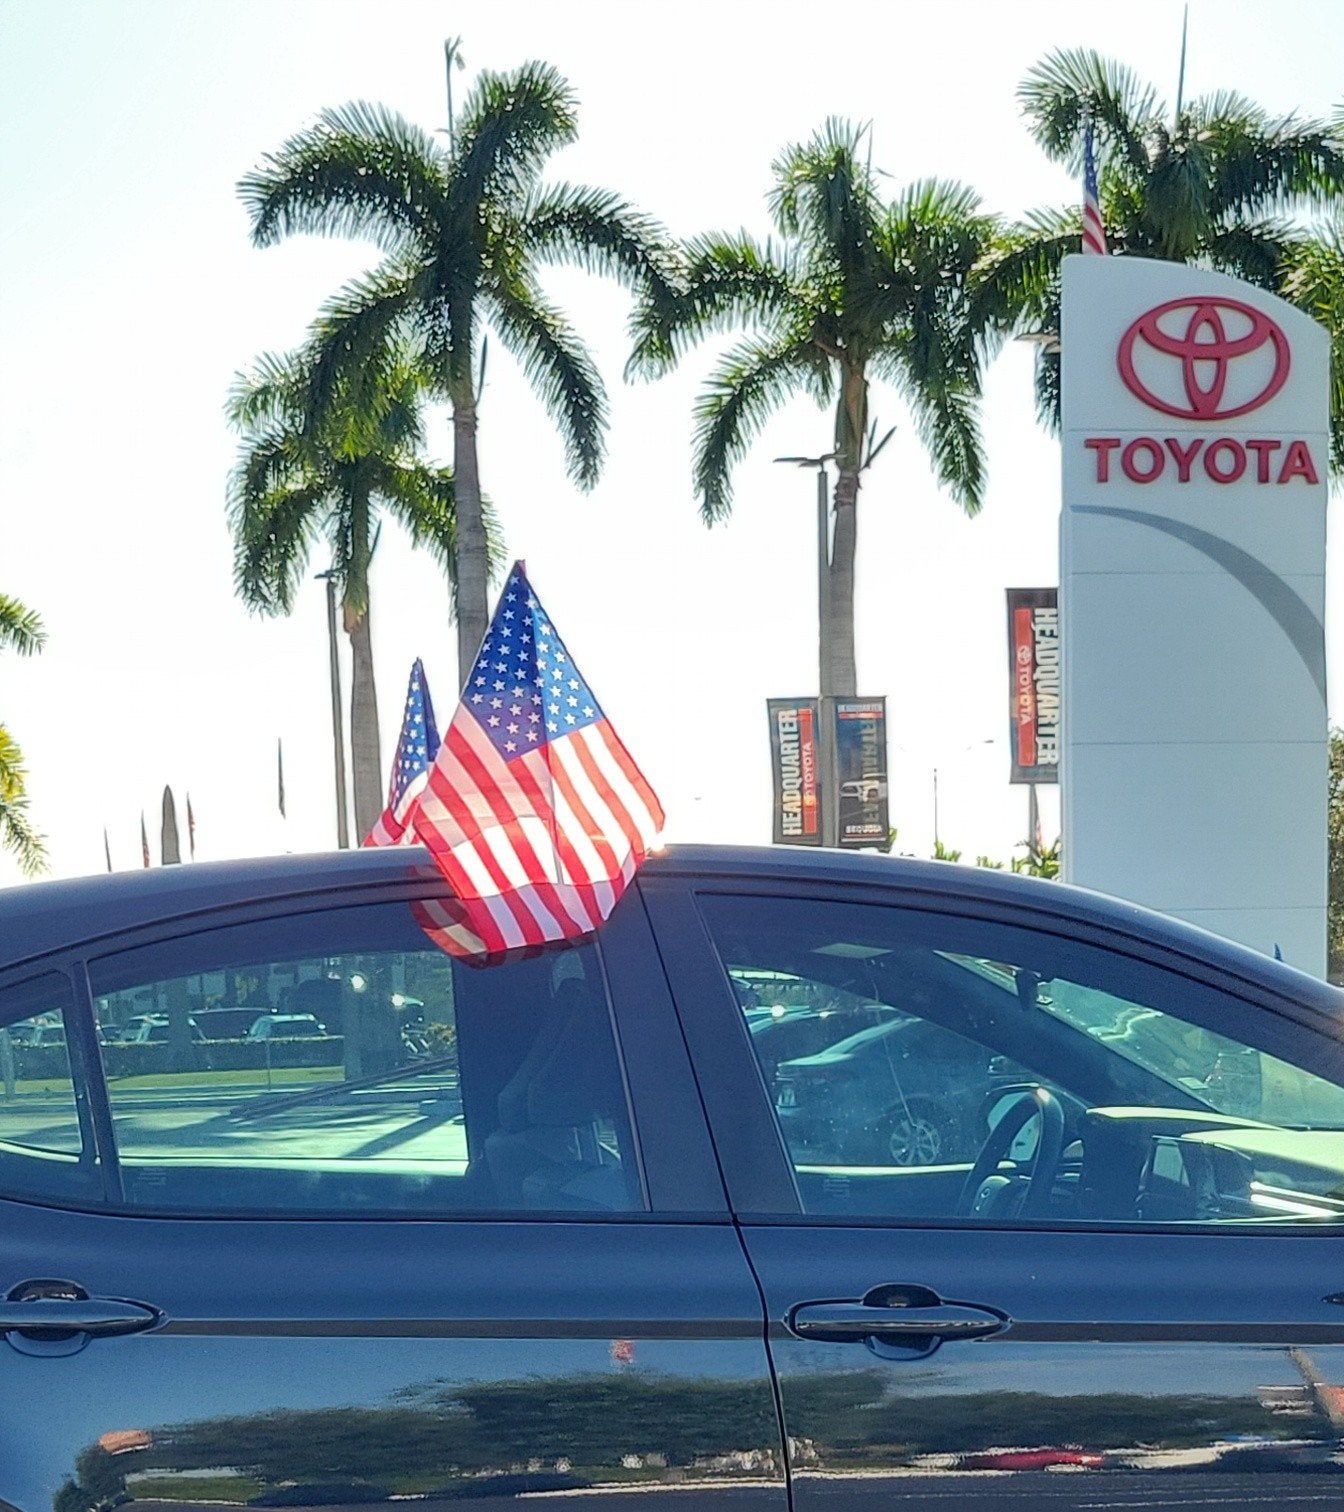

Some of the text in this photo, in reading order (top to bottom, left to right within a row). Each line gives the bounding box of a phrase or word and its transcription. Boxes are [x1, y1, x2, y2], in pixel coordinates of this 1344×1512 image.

[1083, 437, 1320, 485] TOYOTA
[1019, 668, 1034, 726] TOYOTA
[1033, 607, 1060, 765] HEADQUARTER
[778, 709, 803, 836] HEADQUARTER
